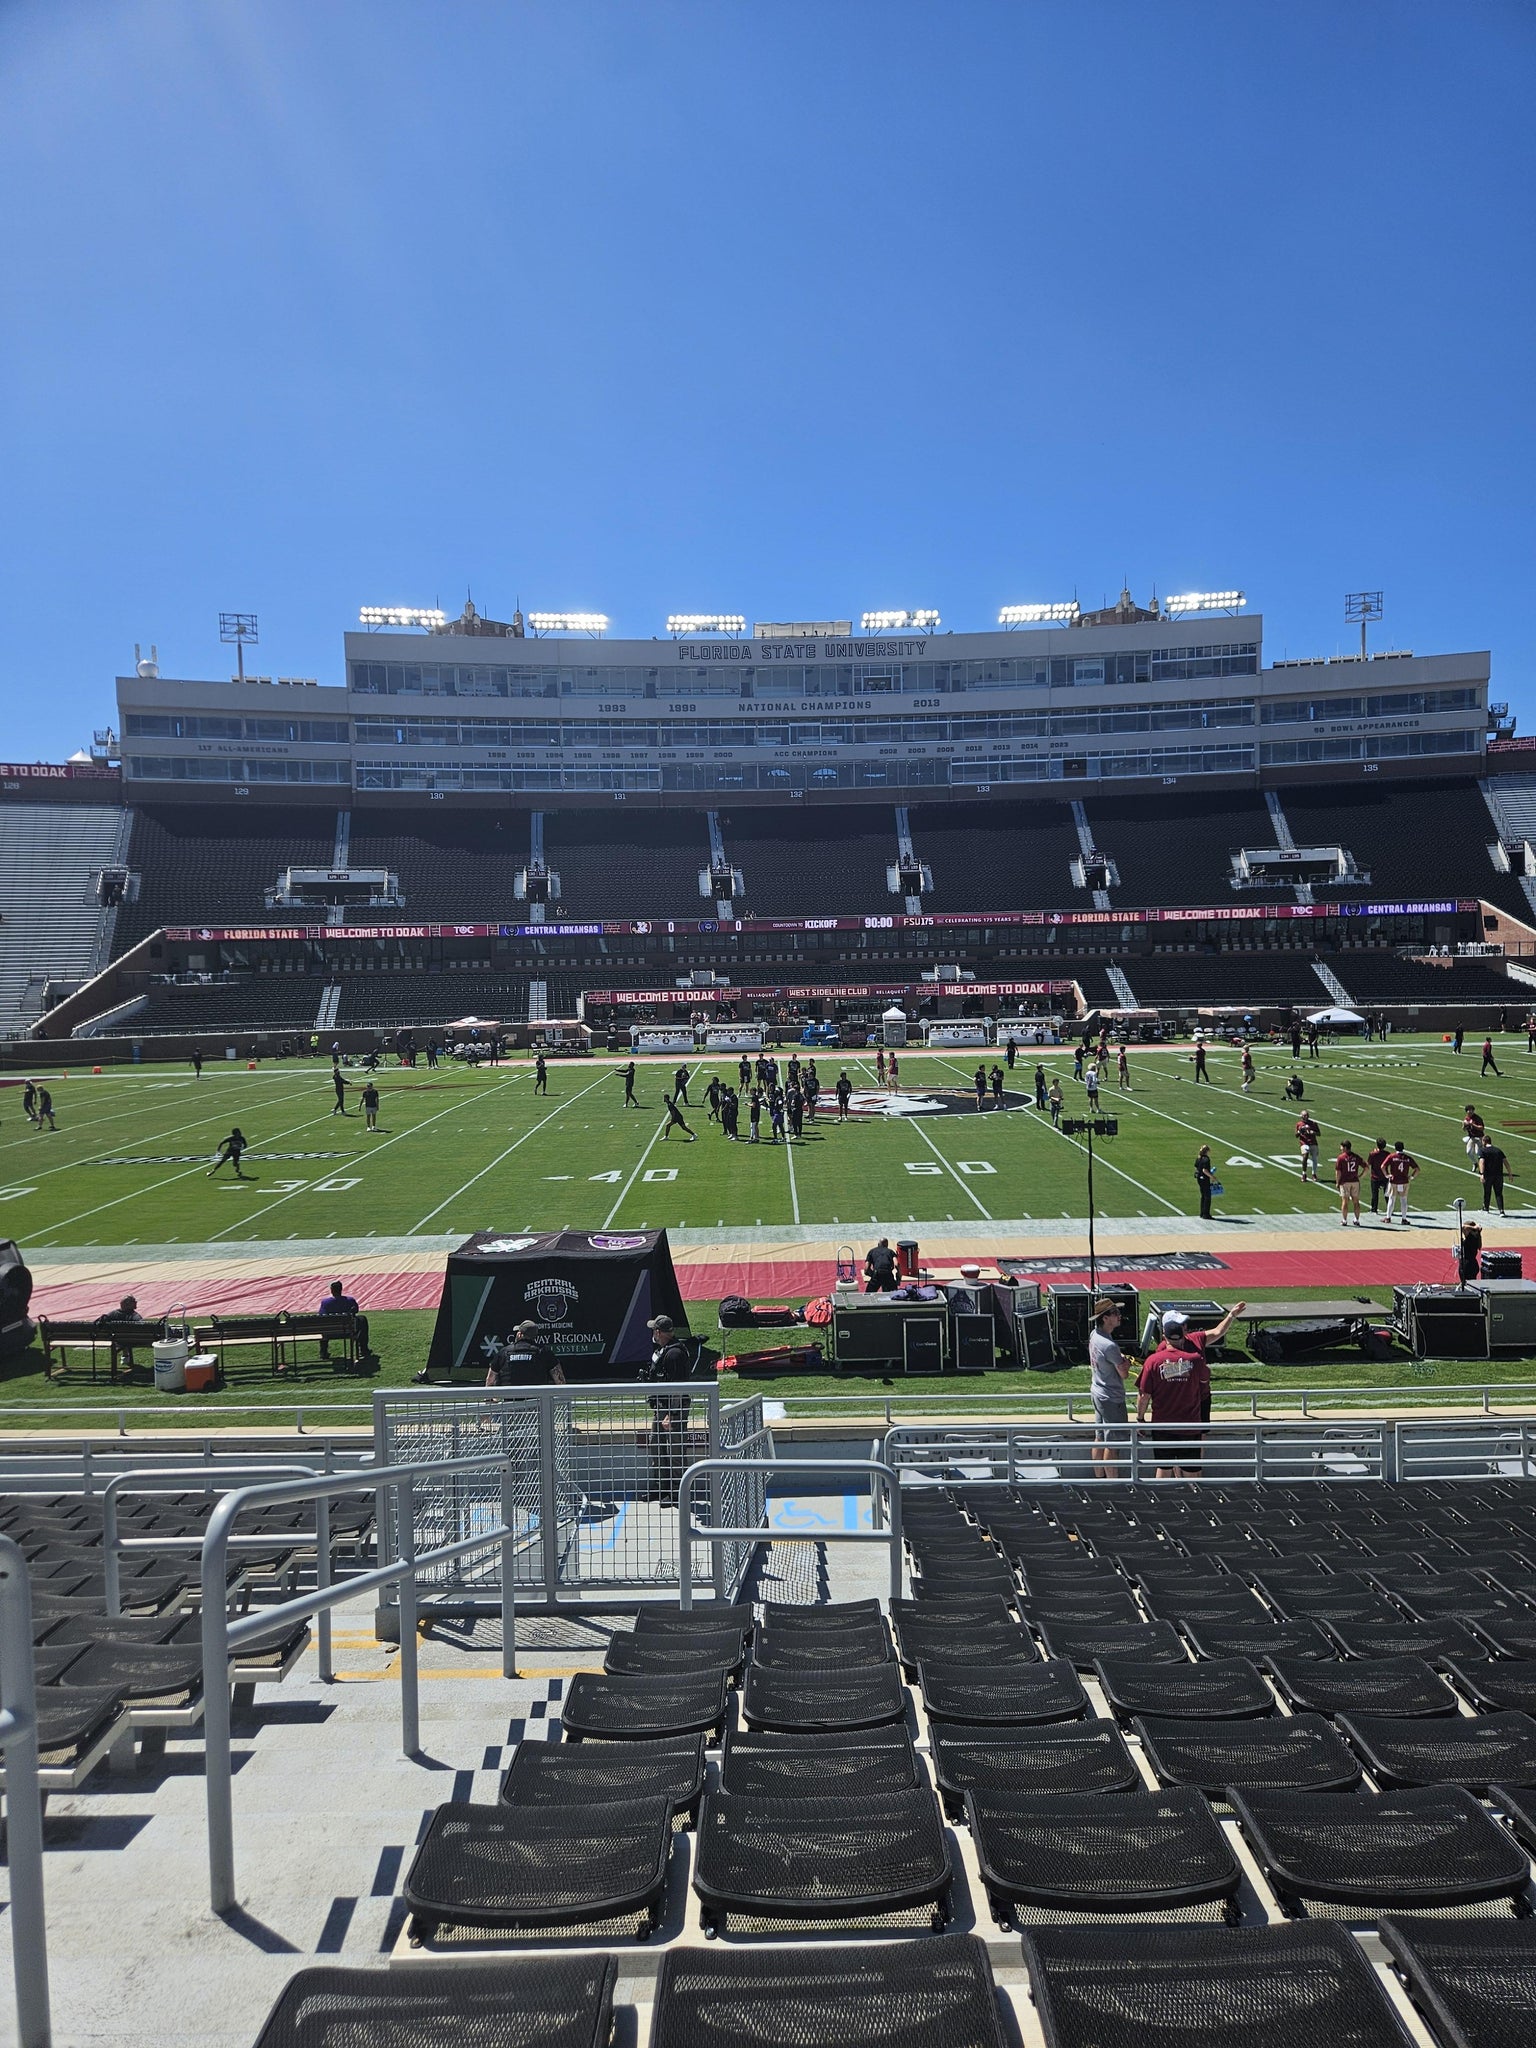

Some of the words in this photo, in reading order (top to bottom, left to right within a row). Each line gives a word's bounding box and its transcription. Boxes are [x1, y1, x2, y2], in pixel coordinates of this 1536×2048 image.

[679, 645, 751, 660] FLORIDA
[761, 644, 816, 659] STATE
[825, 641, 927, 658] UNIVERSITY
[598, 704, 626, 713] 1993
[668, 704, 696, 713] 1999
[738, 702, 796, 712] NATIONAL
[801, 700, 872, 711] CHAMPIONS
[913, 699, 941, 708] 2013
[1331, 724, 1354, 732] BOWL
[1356, 719, 1420, 731] APPEARANCES
[10, 766, 28, 776] TO
[31, 766, 67, 778] DOAK
[1362, 764, 1379, 772] 135
[1162, 777, 1177, 785] 134
[234, 787, 249, 795] 129
[976, 785, 990, 793] 133
[429, 792, 444, 800] 130
[1367, 904, 1404, 914] CENTRAL
[1406, 902, 1452, 913] ARKANSAS
[1072, 913, 1110, 923] FLORIDA
[1112, 912, 1140, 922] STATE
[1164, 910, 1215, 920] WELCOME
[1216, 909, 1231, 919] TO
[1232, 908, 1261, 918] DOAK
[668, 922, 675, 932] 0
[735, 921, 742, 931] 0
[804, 919, 838, 929] KICKOFF
[864, 916, 893, 928] 90:00
[224, 930, 266, 939] FLORIDA
[269, 929, 300, 939] STATE
[325, 928, 378, 938] WELCOME
[379, 928, 394, 937] TO
[396, 927, 425, 937] DOAK
[524, 926, 558, 935] CENTRAL
[559, 925, 599, 934] ARKANSAS
[811, 988, 847, 996] SIDELINE
[847, 987, 868, 995] CLUB
[944, 985, 997, 995] WELCOME
[998, 984, 1013, 994] TO
[1015, 983, 1044, 994] DOAK
[616, 992, 669, 1003] WELCOME
[670, 991, 686, 1001] TO
[687, 990, 715, 1001] DOAK
[903, 1161, 998, 1175] 50
[1347, 1162, 1356, 1172] 12
[1398, 1162, 1404, 1172] 4
[526, 1279, 575, 1291] CENTRAL
[524, 1285, 579, 1300] ARKANSAS
[507, 1335, 550, 1344] CWAY
[553, 1332, 604, 1344] REGIONAL
